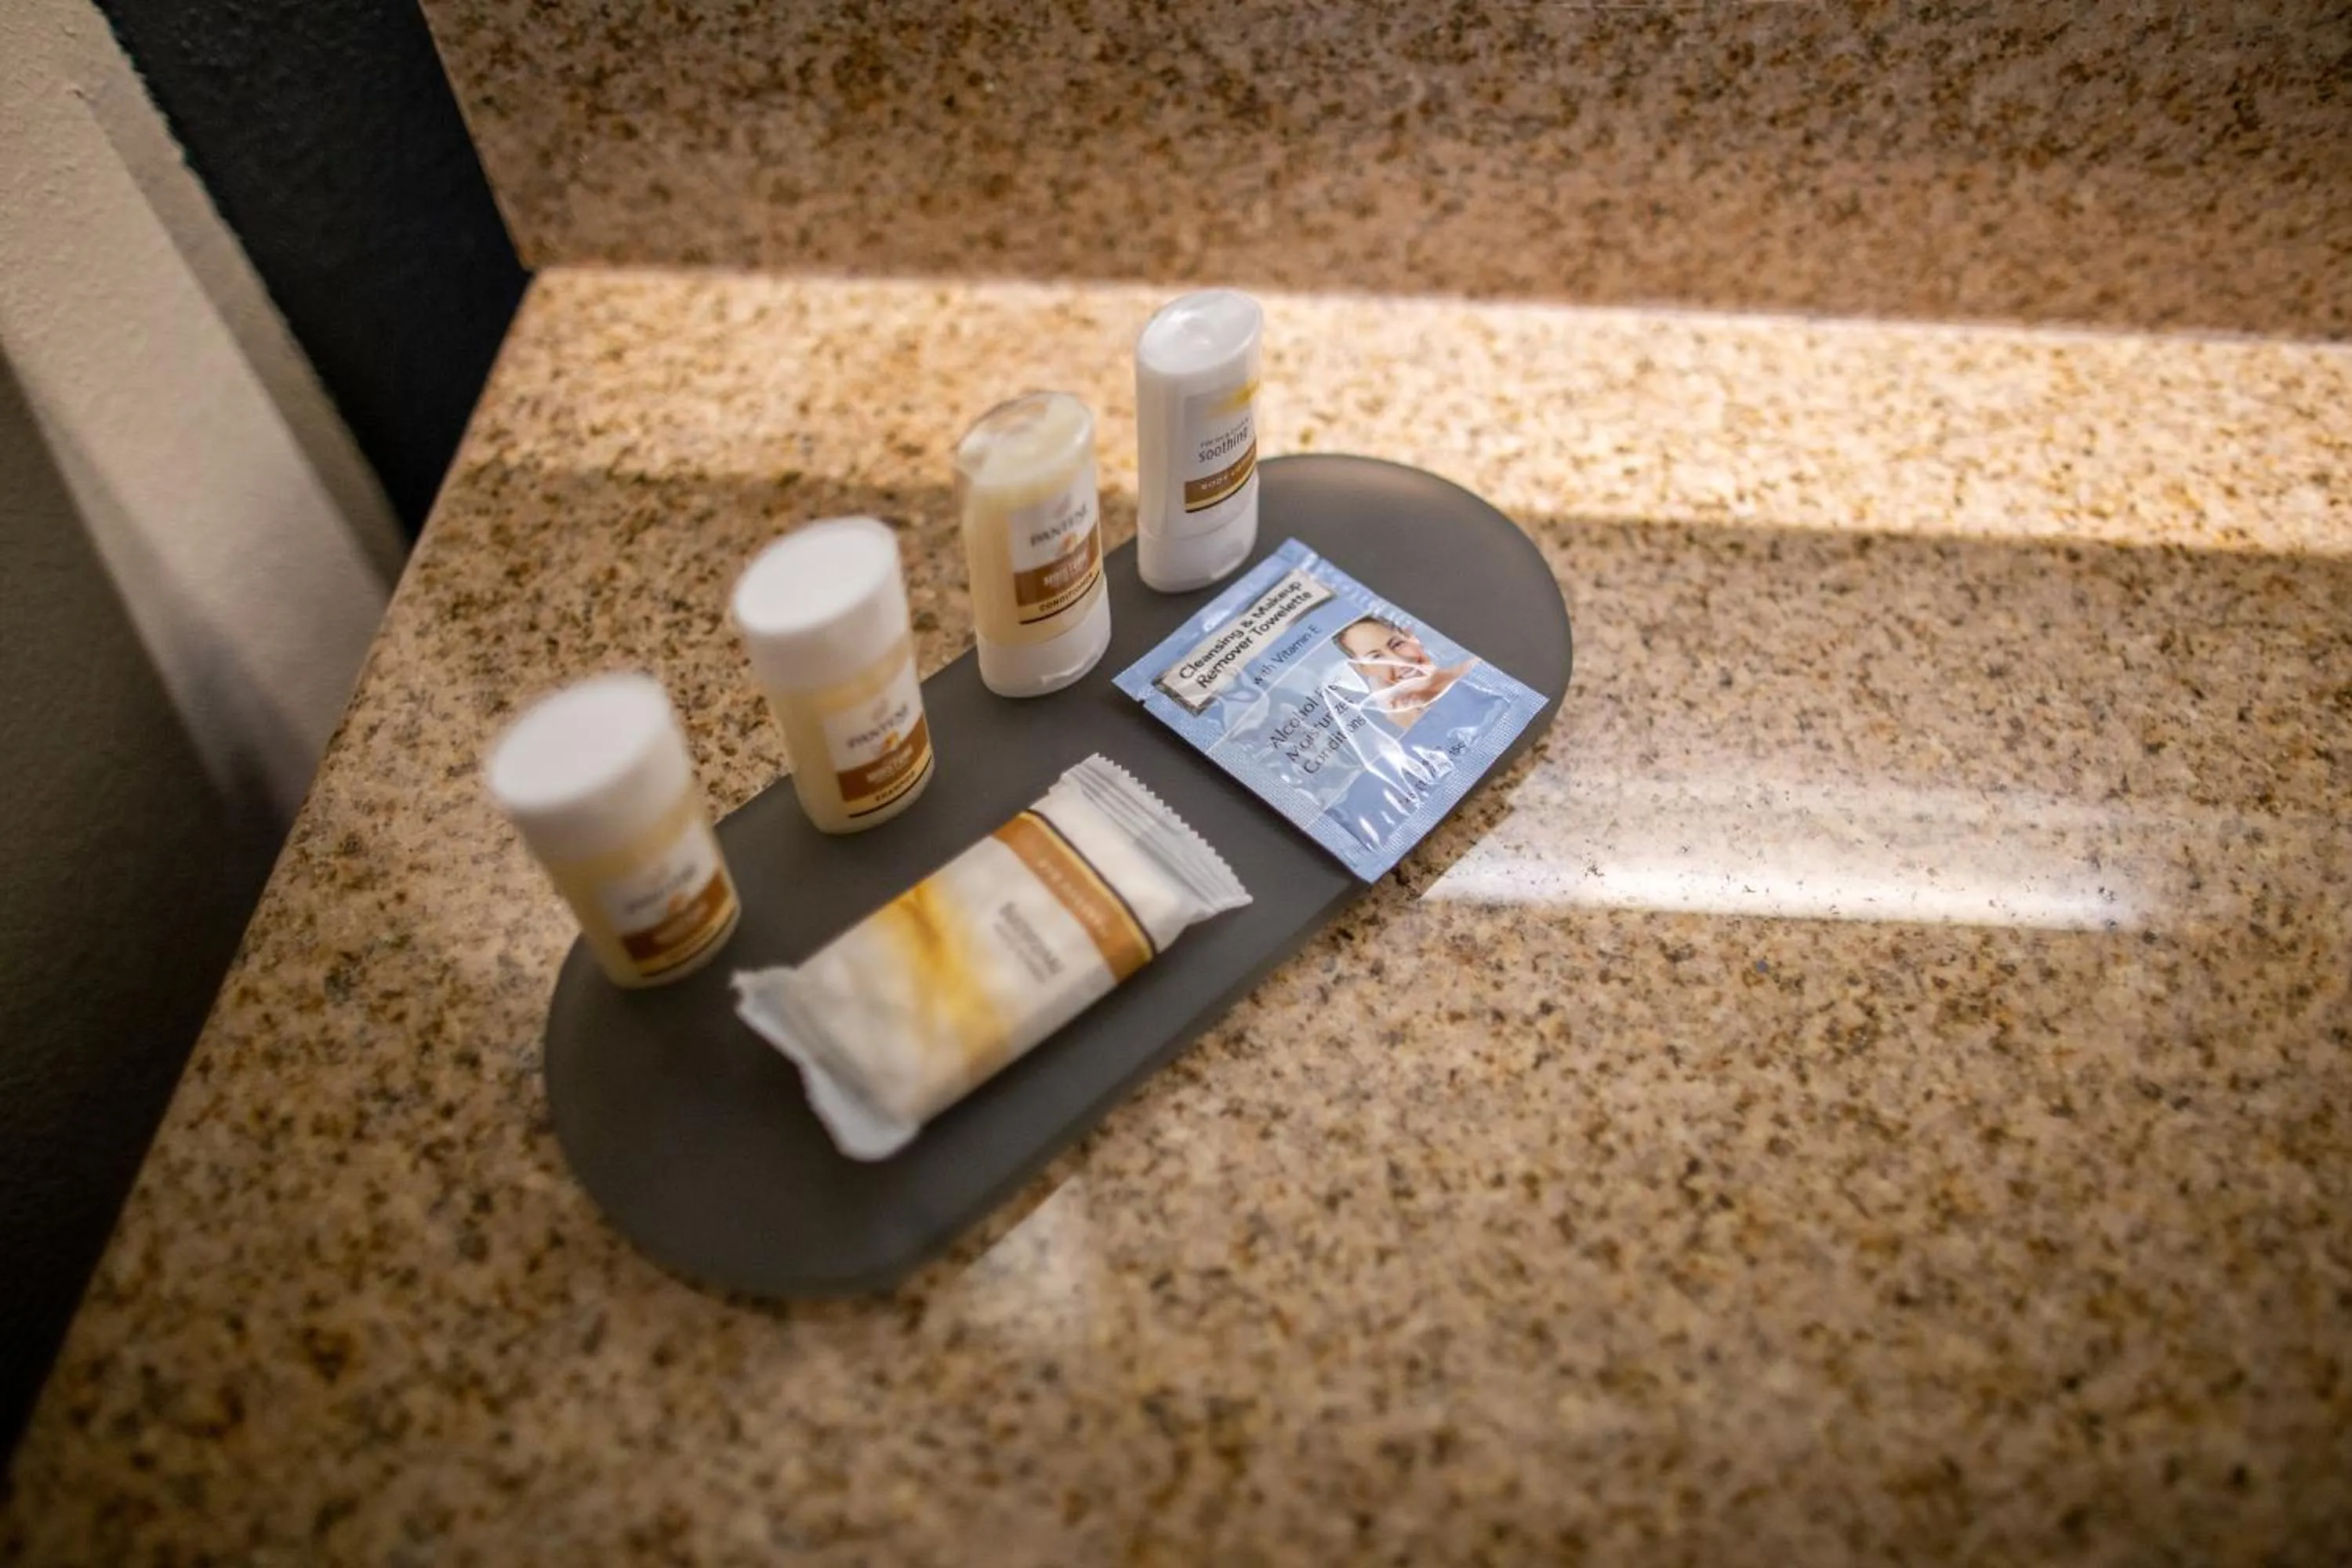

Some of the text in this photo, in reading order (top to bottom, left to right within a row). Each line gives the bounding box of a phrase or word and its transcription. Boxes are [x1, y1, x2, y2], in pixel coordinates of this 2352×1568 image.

[1178, 580, 1302, 680] Cleansing & Makeup
[1196, 590, 1313, 689] Remover Towelette
[1270, 632, 1314, 664] Vitamin
[1269, 695, 1320, 750] Alcohol
[1286, 695, 1354, 763] Moisturzes
[1302, 713, 1367, 774] Conditons
